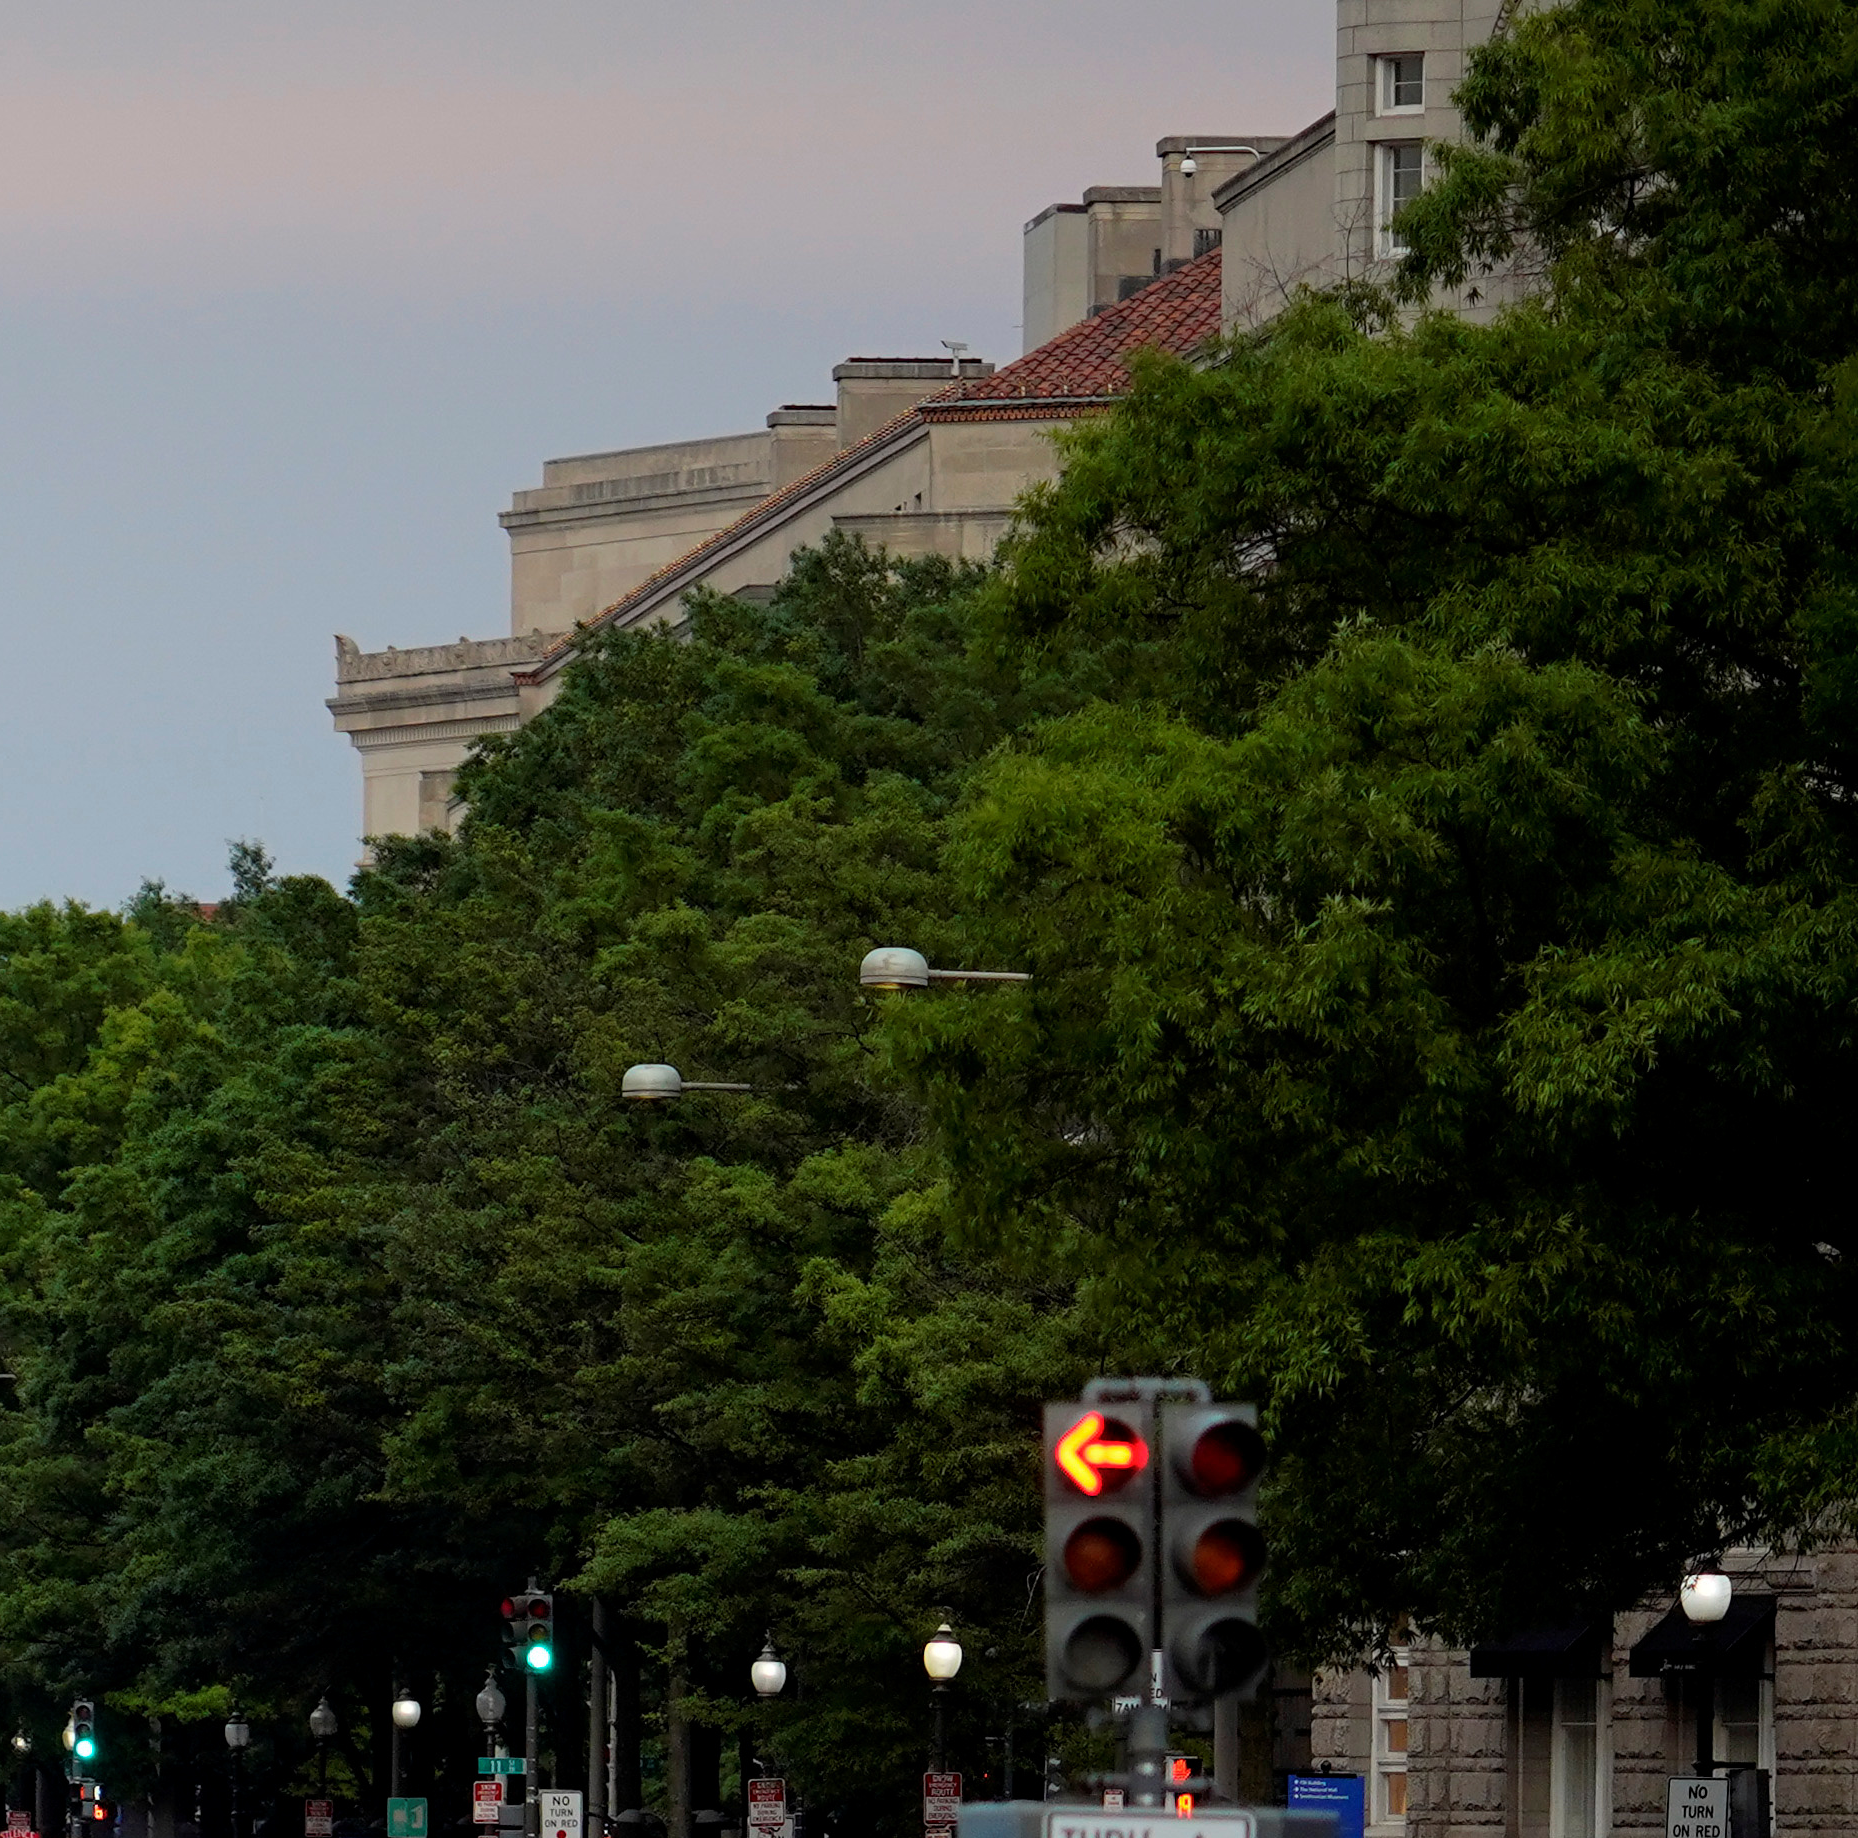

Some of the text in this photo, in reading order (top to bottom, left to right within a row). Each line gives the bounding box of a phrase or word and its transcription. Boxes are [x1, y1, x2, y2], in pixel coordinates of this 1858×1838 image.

[1688, 1785, 1708, 1799] NO
[552, 1796, 570, 1806] NO
[550, 1808, 573, 1817] TURN
[1682, 1805, 1714, 1819] TURN
[545, 1820, 578, 1828] ON RED
[1673, 1825, 1721, 1838] ON RED
